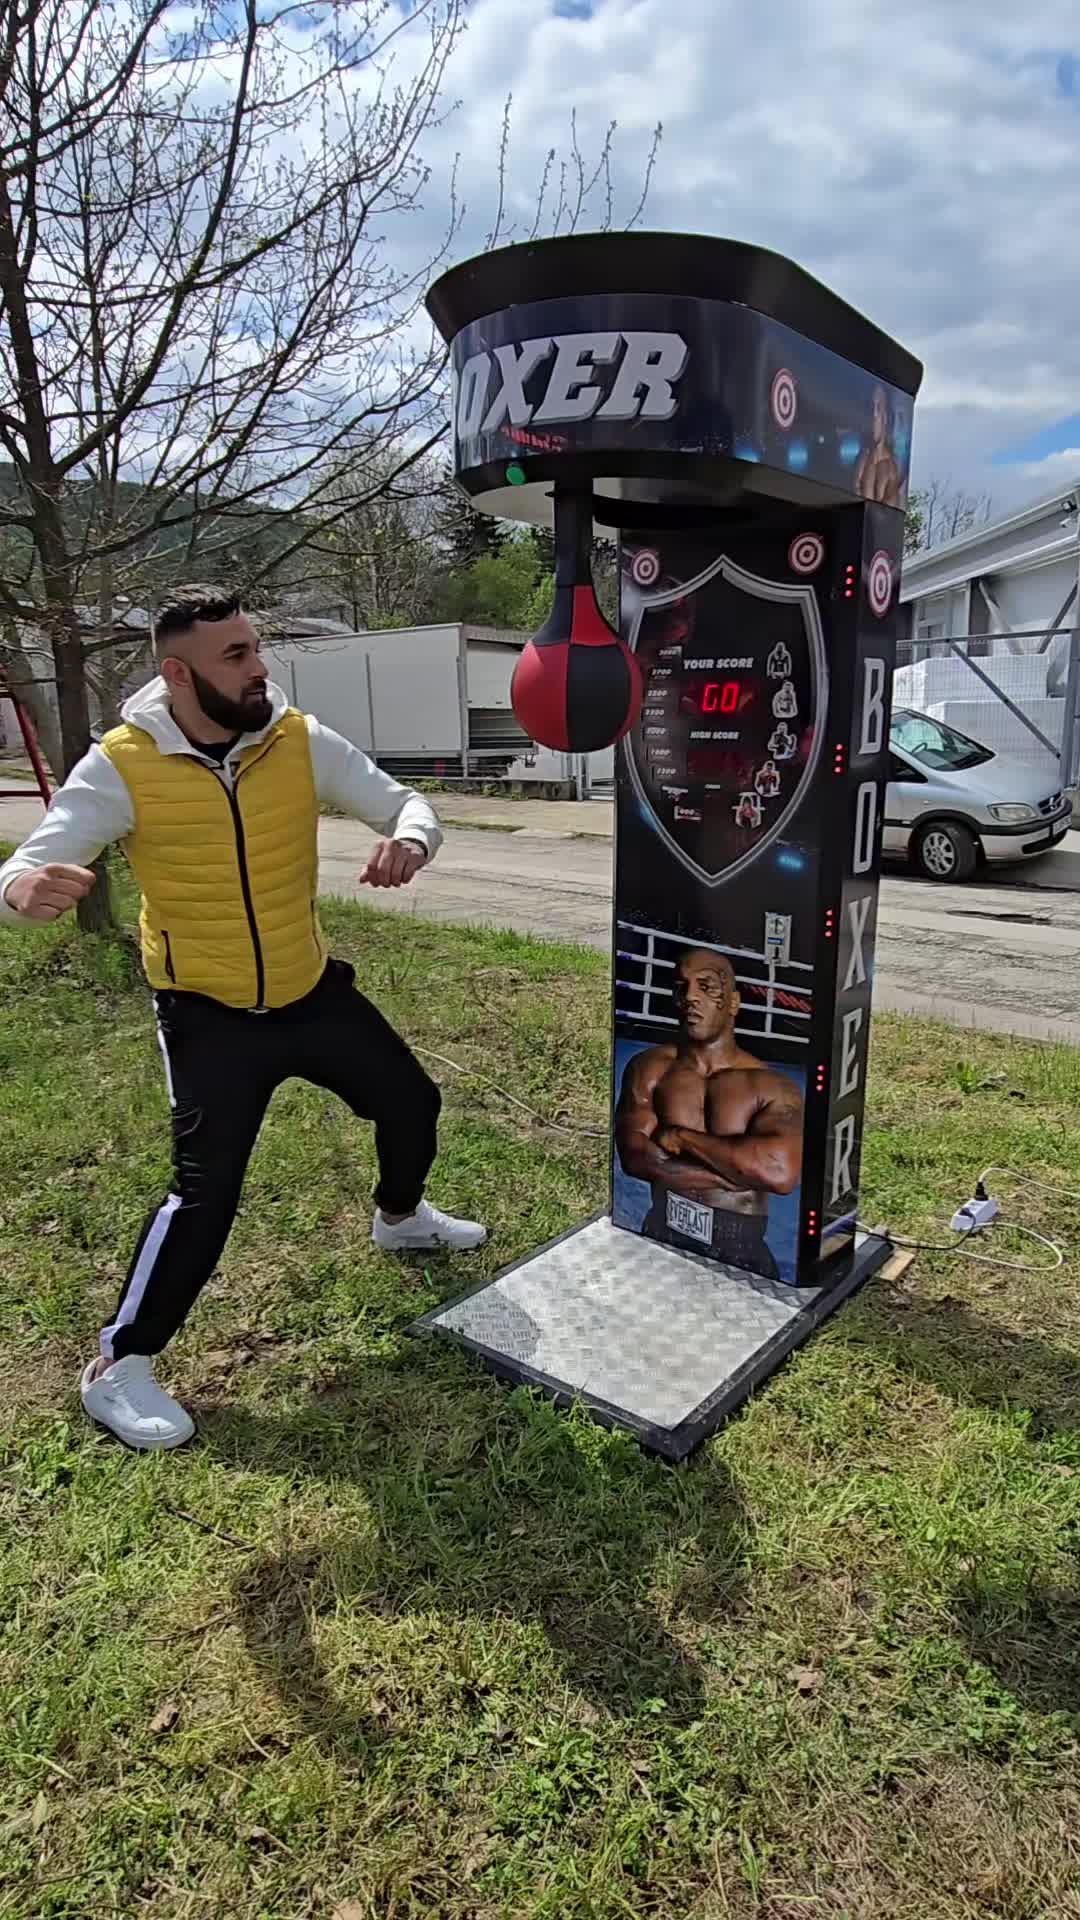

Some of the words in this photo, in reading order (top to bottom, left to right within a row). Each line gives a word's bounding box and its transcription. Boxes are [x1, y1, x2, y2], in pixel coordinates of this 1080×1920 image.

[454, 332, 690, 440] OXER
[683, 659, 714, 670] YOUR
[716, 657, 754, 668] SCORE
[702, 682, 740, 712] GO
[690, 731, 712, 739] HIGH
[712, 731, 740, 740] SCORE
[829, 656, 886, 1205] BOXER
